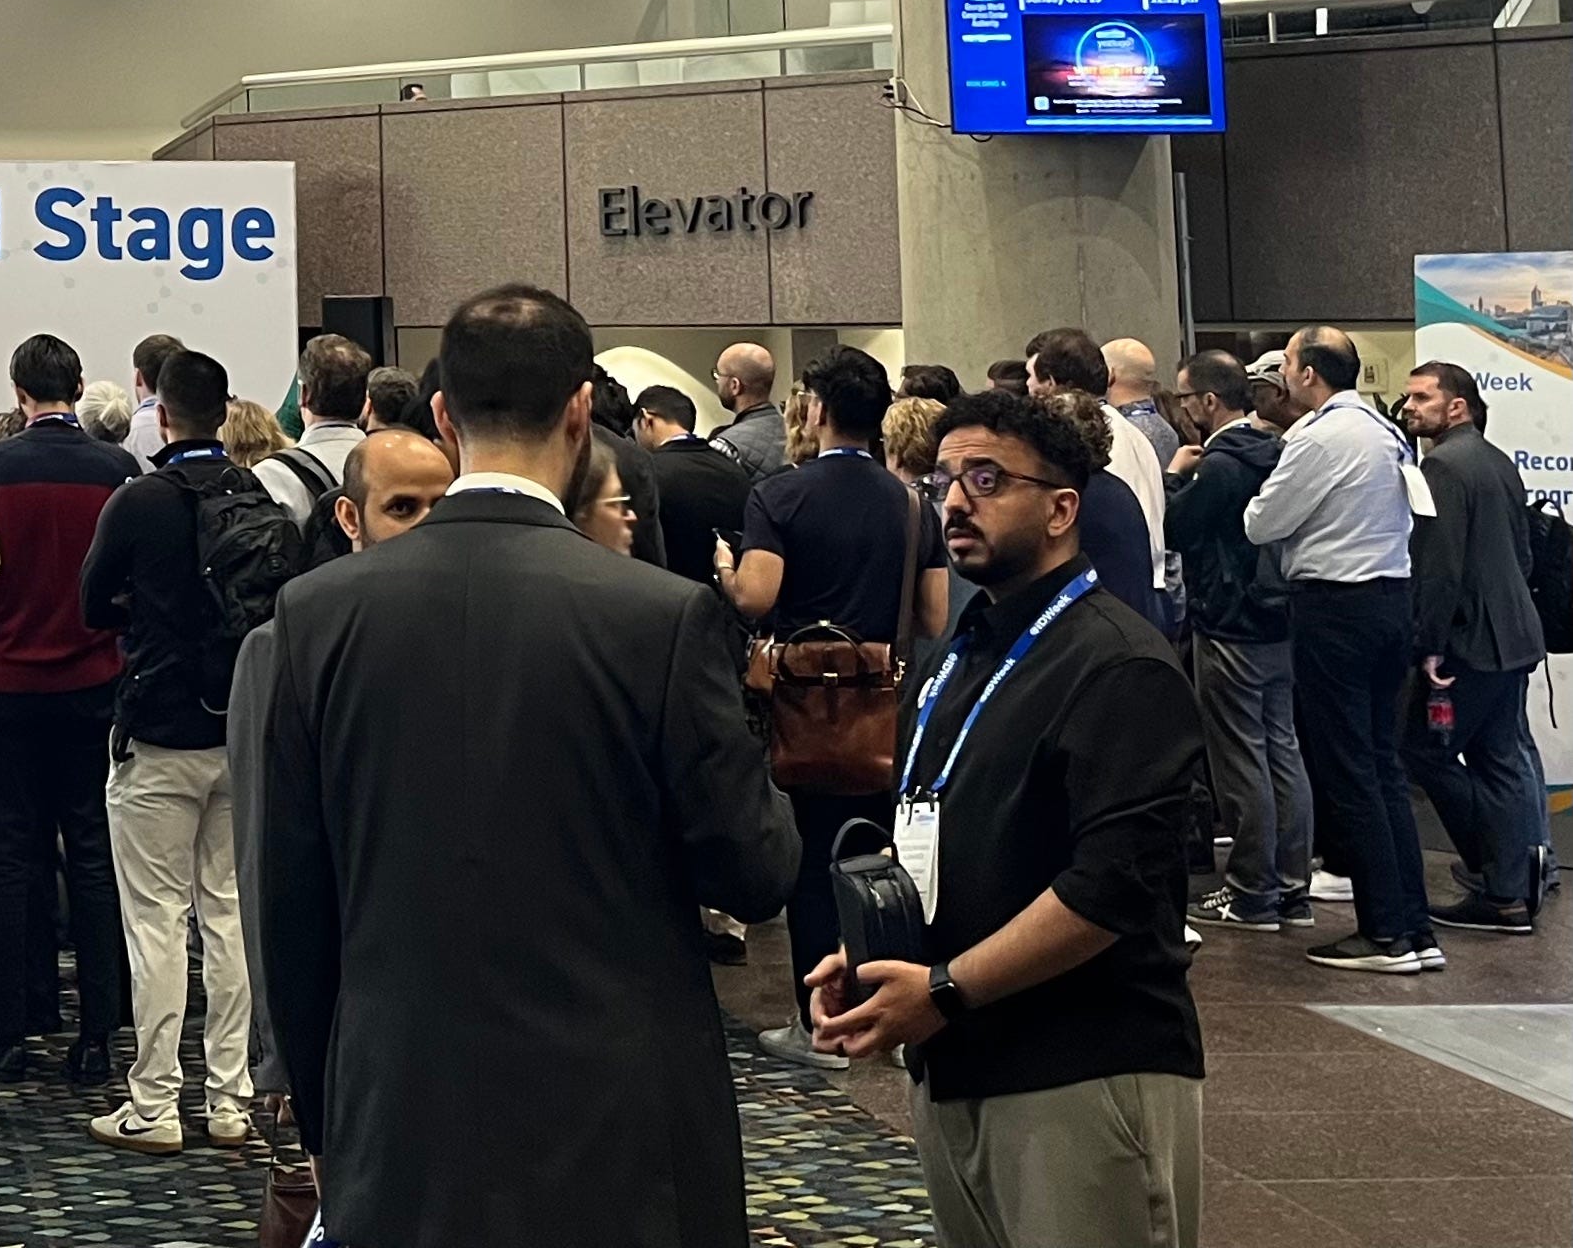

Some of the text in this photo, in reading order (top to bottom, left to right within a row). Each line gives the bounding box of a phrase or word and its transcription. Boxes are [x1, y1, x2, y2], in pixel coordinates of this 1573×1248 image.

[34, 186, 276, 281] Stage
[598, 185, 814, 238] Elevator
[1514, 450, 1573, 471] Reco
[1035, 594, 1072, 630] IDWeek
